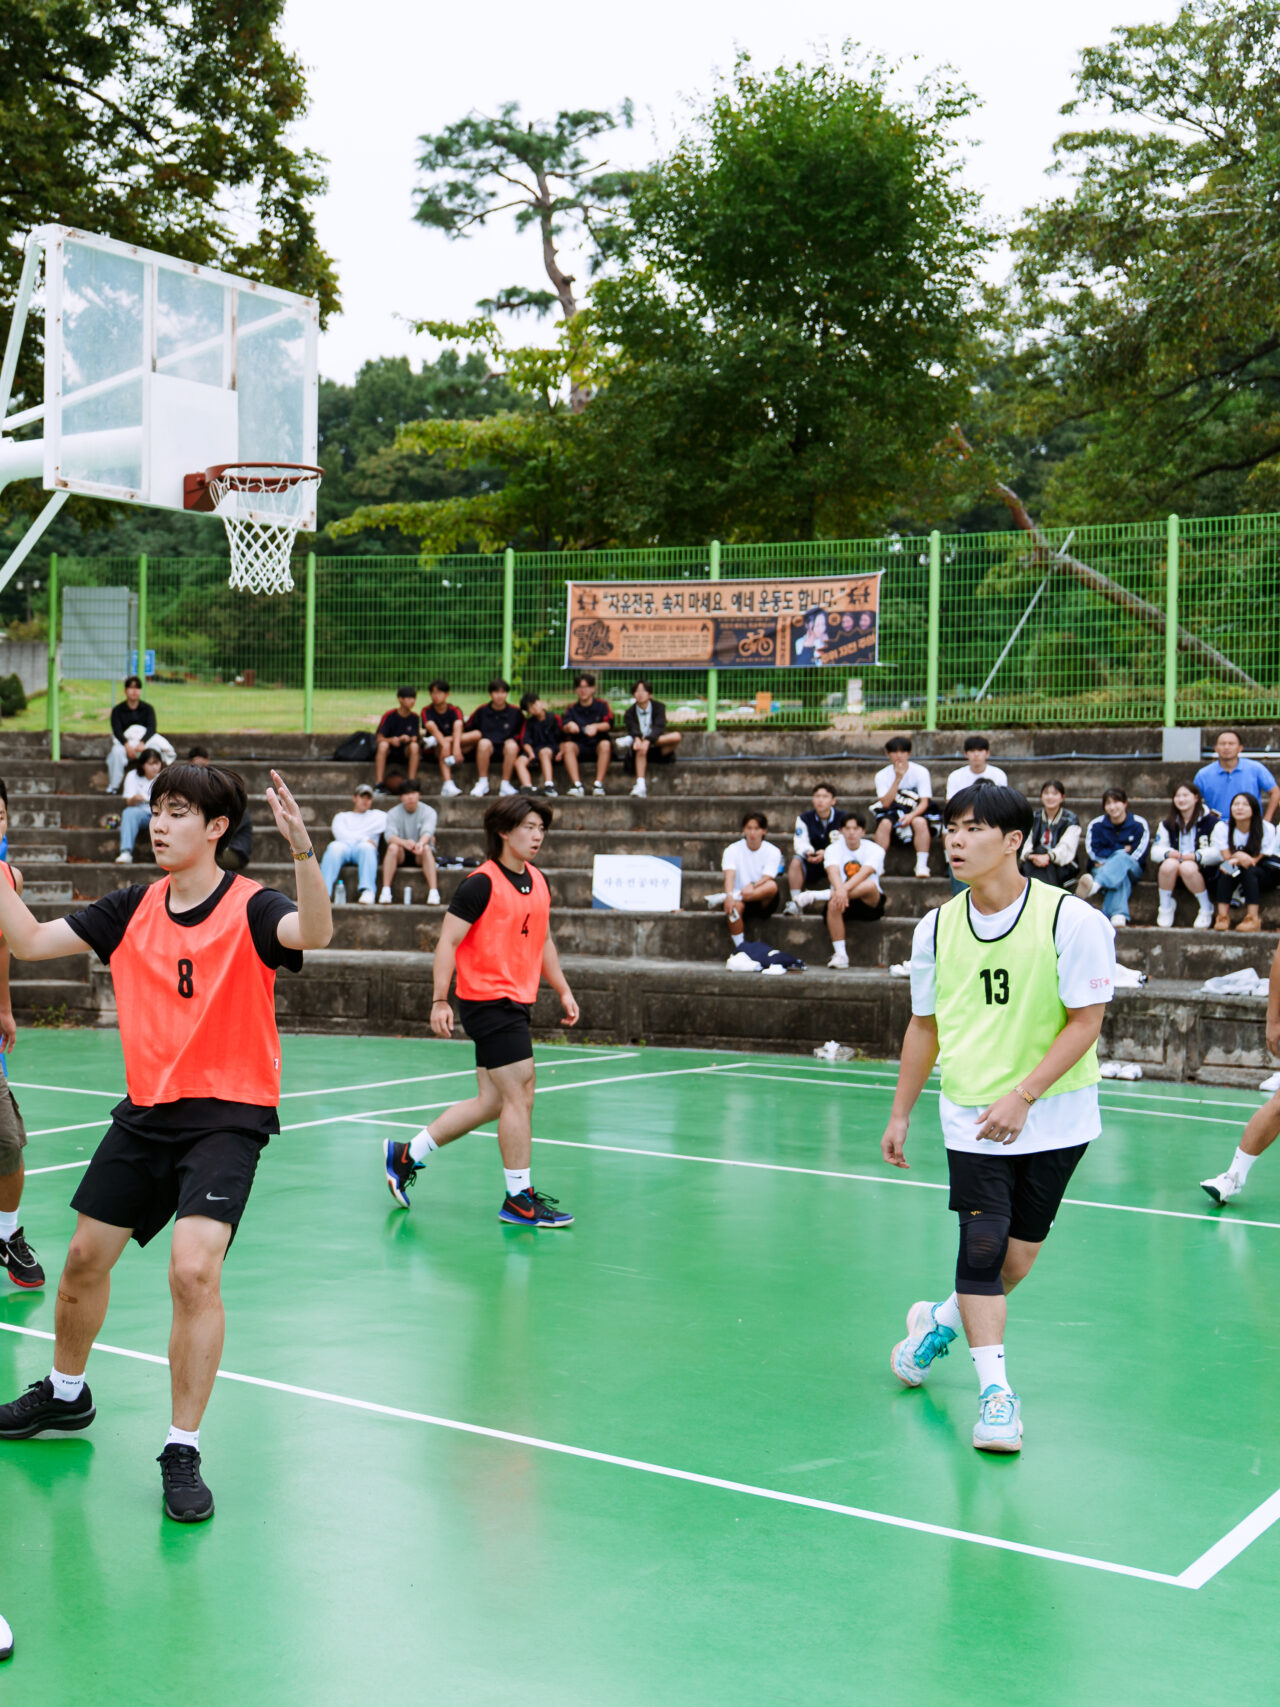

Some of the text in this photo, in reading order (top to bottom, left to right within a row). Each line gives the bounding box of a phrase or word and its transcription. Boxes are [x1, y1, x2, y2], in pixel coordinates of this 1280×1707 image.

[661, 592, 685, 613] 속지
[688, 591, 728, 613] 마세요.
[758, 590, 795, 612] 운동도
[520, 913, 530, 937] 4
[177, 958, 194, 999] 8
[979, 968, 1010, 1005] 13
